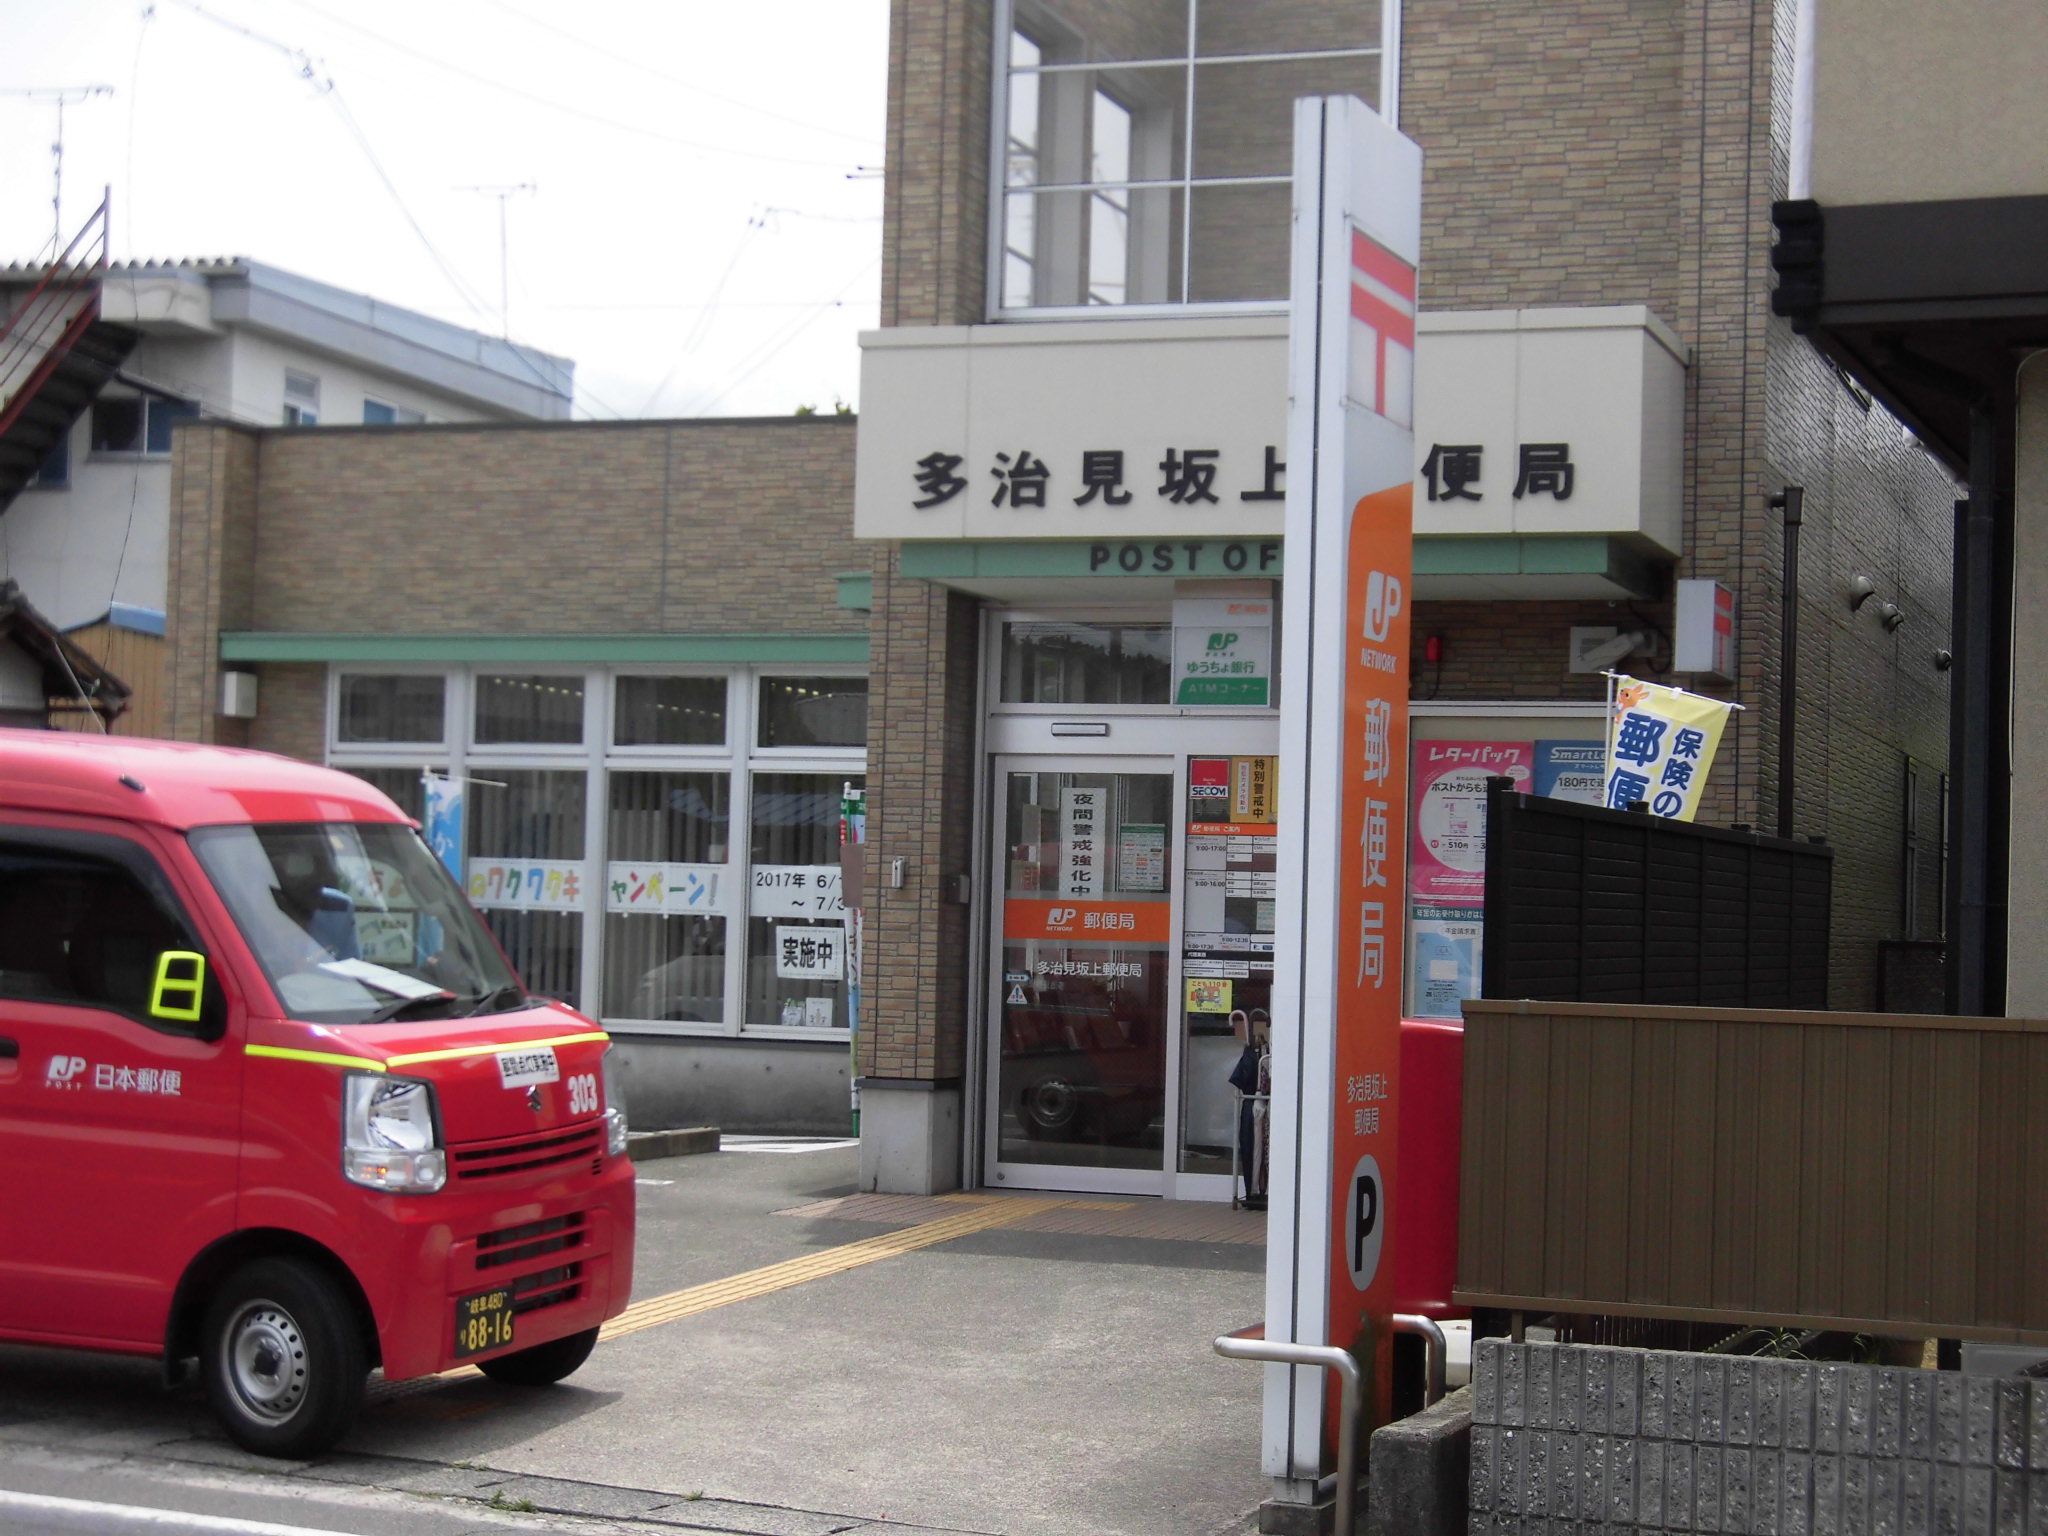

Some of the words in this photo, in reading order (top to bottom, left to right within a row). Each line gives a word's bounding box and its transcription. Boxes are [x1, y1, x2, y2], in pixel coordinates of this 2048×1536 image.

[912, 442, 1575, 509] 多治見坂上便局
[1090, 545, 1203, 572] POST
[1187, 661, 1255, 674] ゆうちょ銀行
[1361, 648, 1397, 674] NETWORK
[1429, 746, 1521, 764] レターパック
[1192, 786, 1226, 796] SECOM
[1070, 793, 1094, 897] 夜間警戒強化中
[1357, 698, 1392, 989] 郵便局
[756, 872, 806, 889] 2017年
[816, 873, 843, 889] 6/
[1083, 912, 1136, 930] 郵便局
[783, 936, 833, 969] 実施中
[1036, 960, 1143, 978] 多治見坂上郵便局
[95, 1063, 182, 1096] 日本郵便
[567, 1073, 598, 1115] 303
[1347, 1073, 1388, 1104] 多治見坂上
[1354, 1107, 1380, 1136] 郵便局
[1354, 1174, 1377, 1273] P
